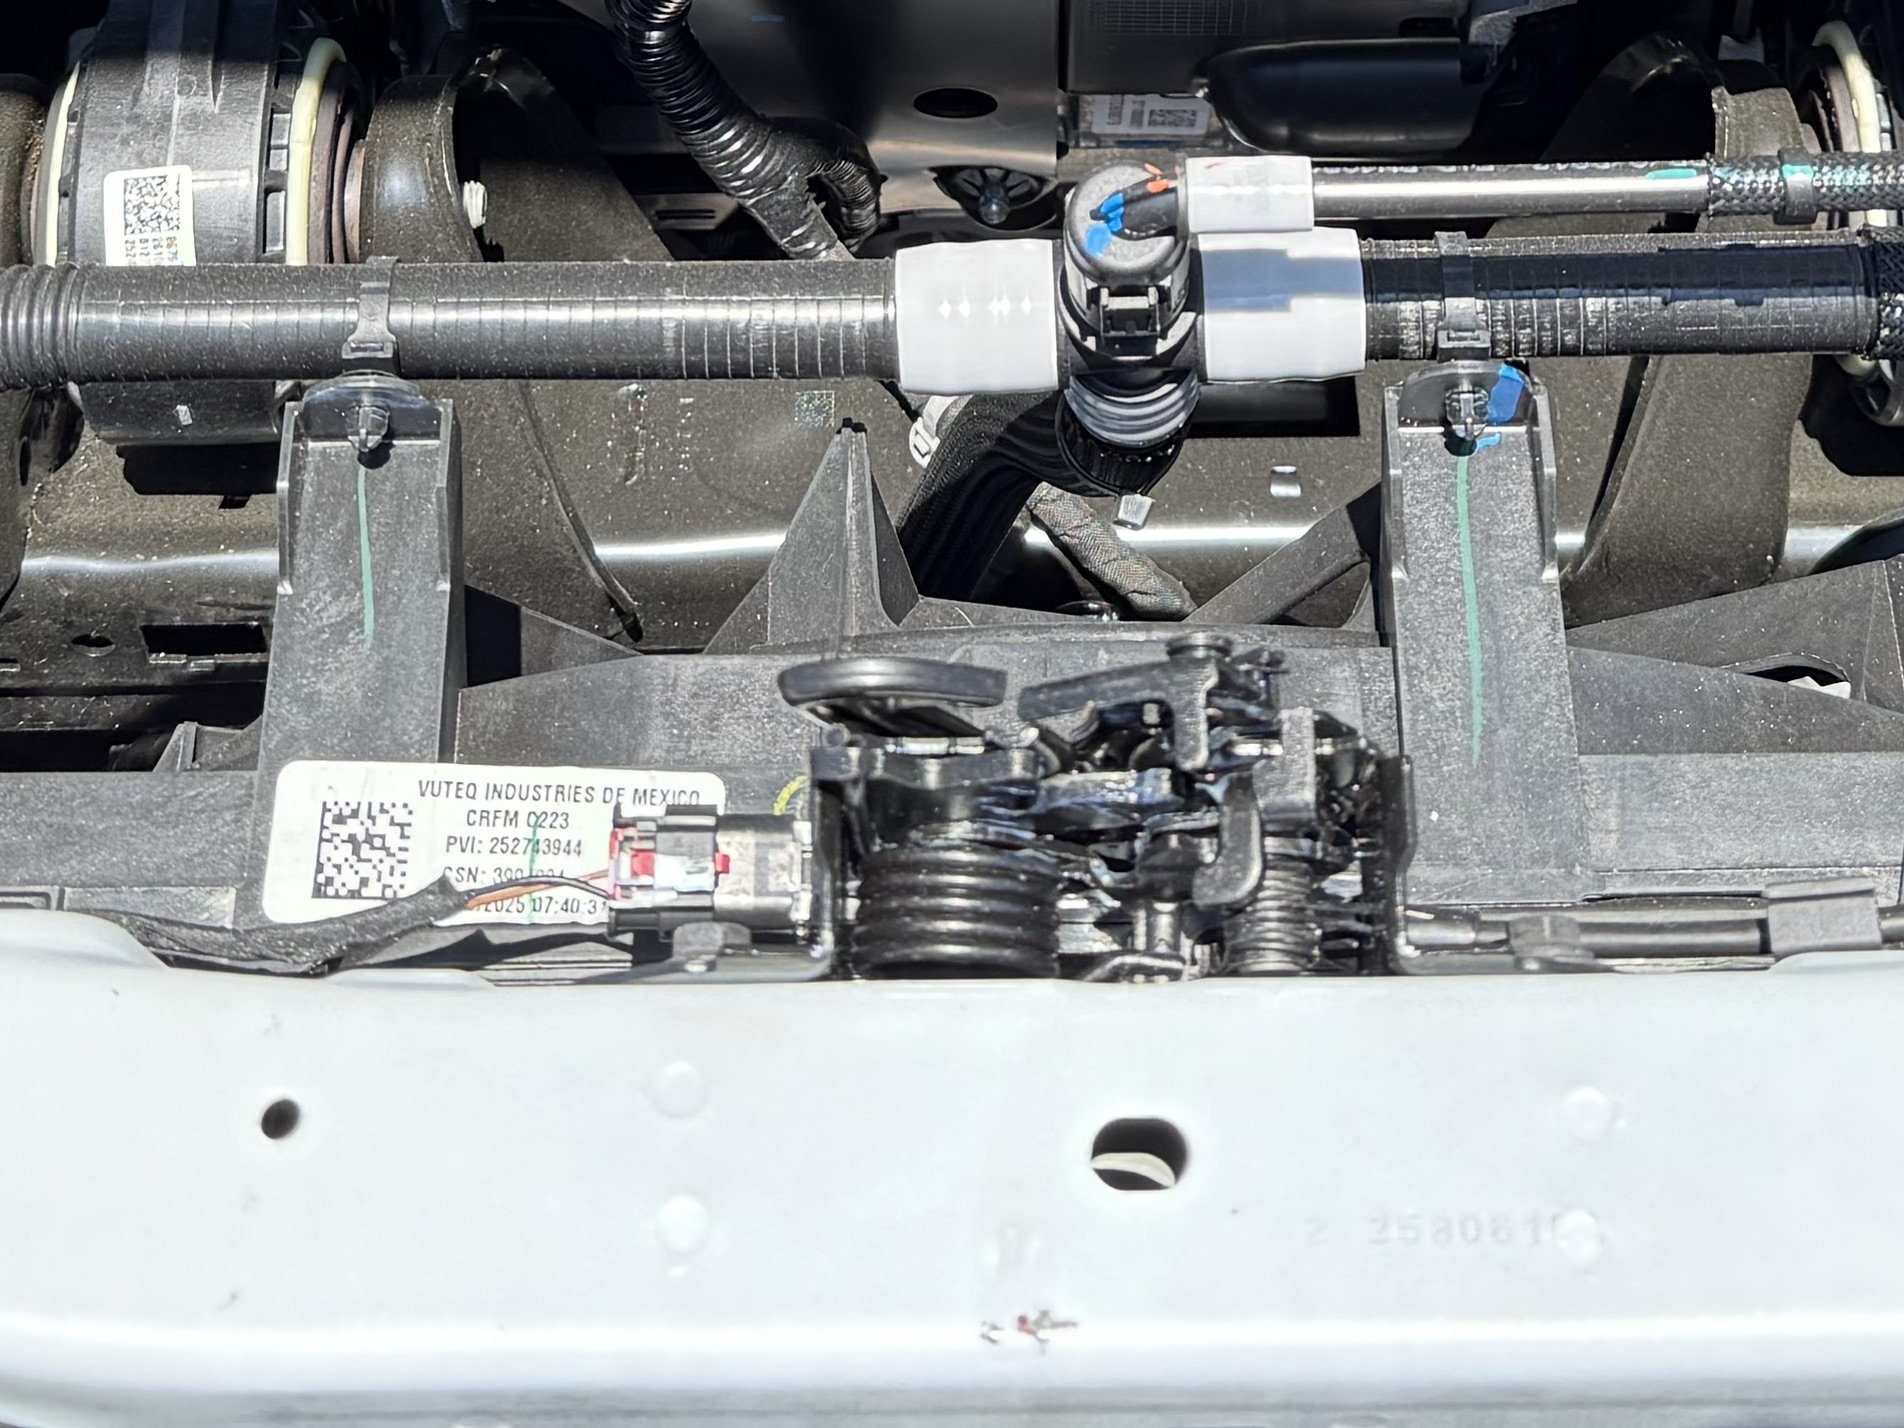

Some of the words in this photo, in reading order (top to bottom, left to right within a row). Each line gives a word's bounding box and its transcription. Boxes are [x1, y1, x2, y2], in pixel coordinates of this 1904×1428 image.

[419, 780, 477, 800] VUTEQ
[485, 784, 595, 804] INDUSTRIES
[603, 787, 625, 804] DE
[632, 789, 700, 806] MEXICO
[467, 810, 519, 828] CRFM
[527, 811, 570, 829] 0223
[446, 836, 482, 854] PVI:
[489, 836, 583, 856] 252743944
